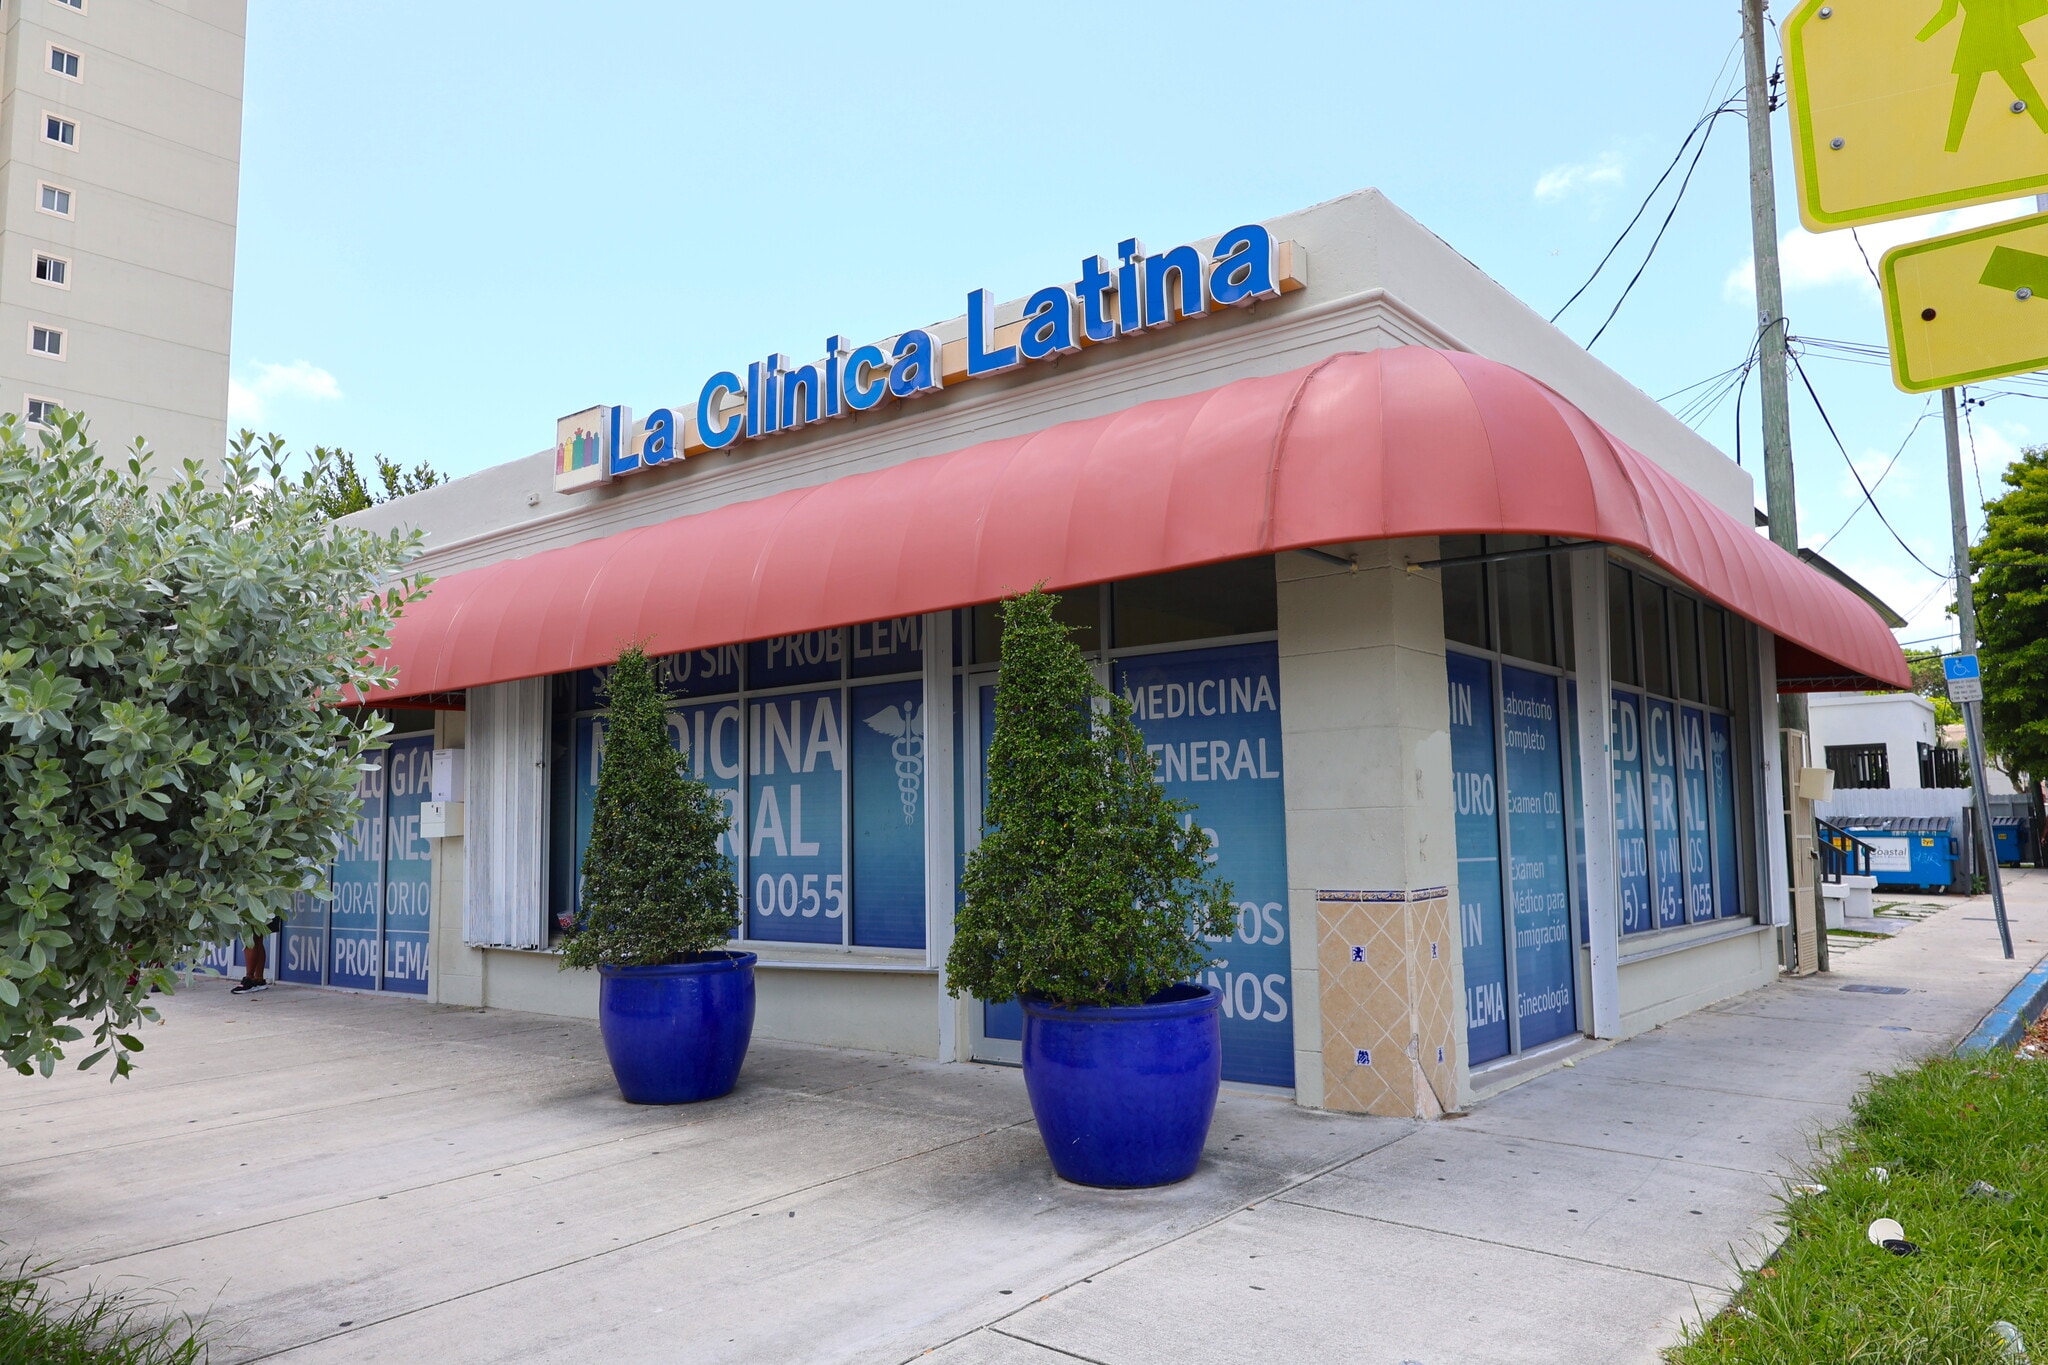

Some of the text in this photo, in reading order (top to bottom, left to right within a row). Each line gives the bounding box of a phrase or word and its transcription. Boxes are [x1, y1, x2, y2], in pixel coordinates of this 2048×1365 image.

[610, 223, 1279, 477] La Clinica Latina
[700, 645, 742, 679] SIN
[1126, 675, 1277, 721] MEDICINA
[1450, 681, 1473, 727] IN
[590, 697, 843, 786] DICINA
[1503, 722, 1546, 754] Completo
[1611, 698, 1705, 771] EDICINA
[1146, 737, 1280, 784] ENERAL
[1507, 790, 1541, 814] Examen
[1543, 791, 1561, 814] CDL
[1612, 769, 1706, 832] ENERAL
[333, 814, 433, 862] AMENES
[1511, 856, 1545, 880] Examen
[1660, 849, 1668, 883] y
[755, 872, 843, 919] 0055
[1512, 890, 1566, 917] Médico para
[1692, 882, 1713, 918] 055
[1460, 902, 1568, 952] IN Inmigración
[287, 934, 430, 981] SIN PROBLEMA
[1517, 983, 1570, 1018] Ginecología
